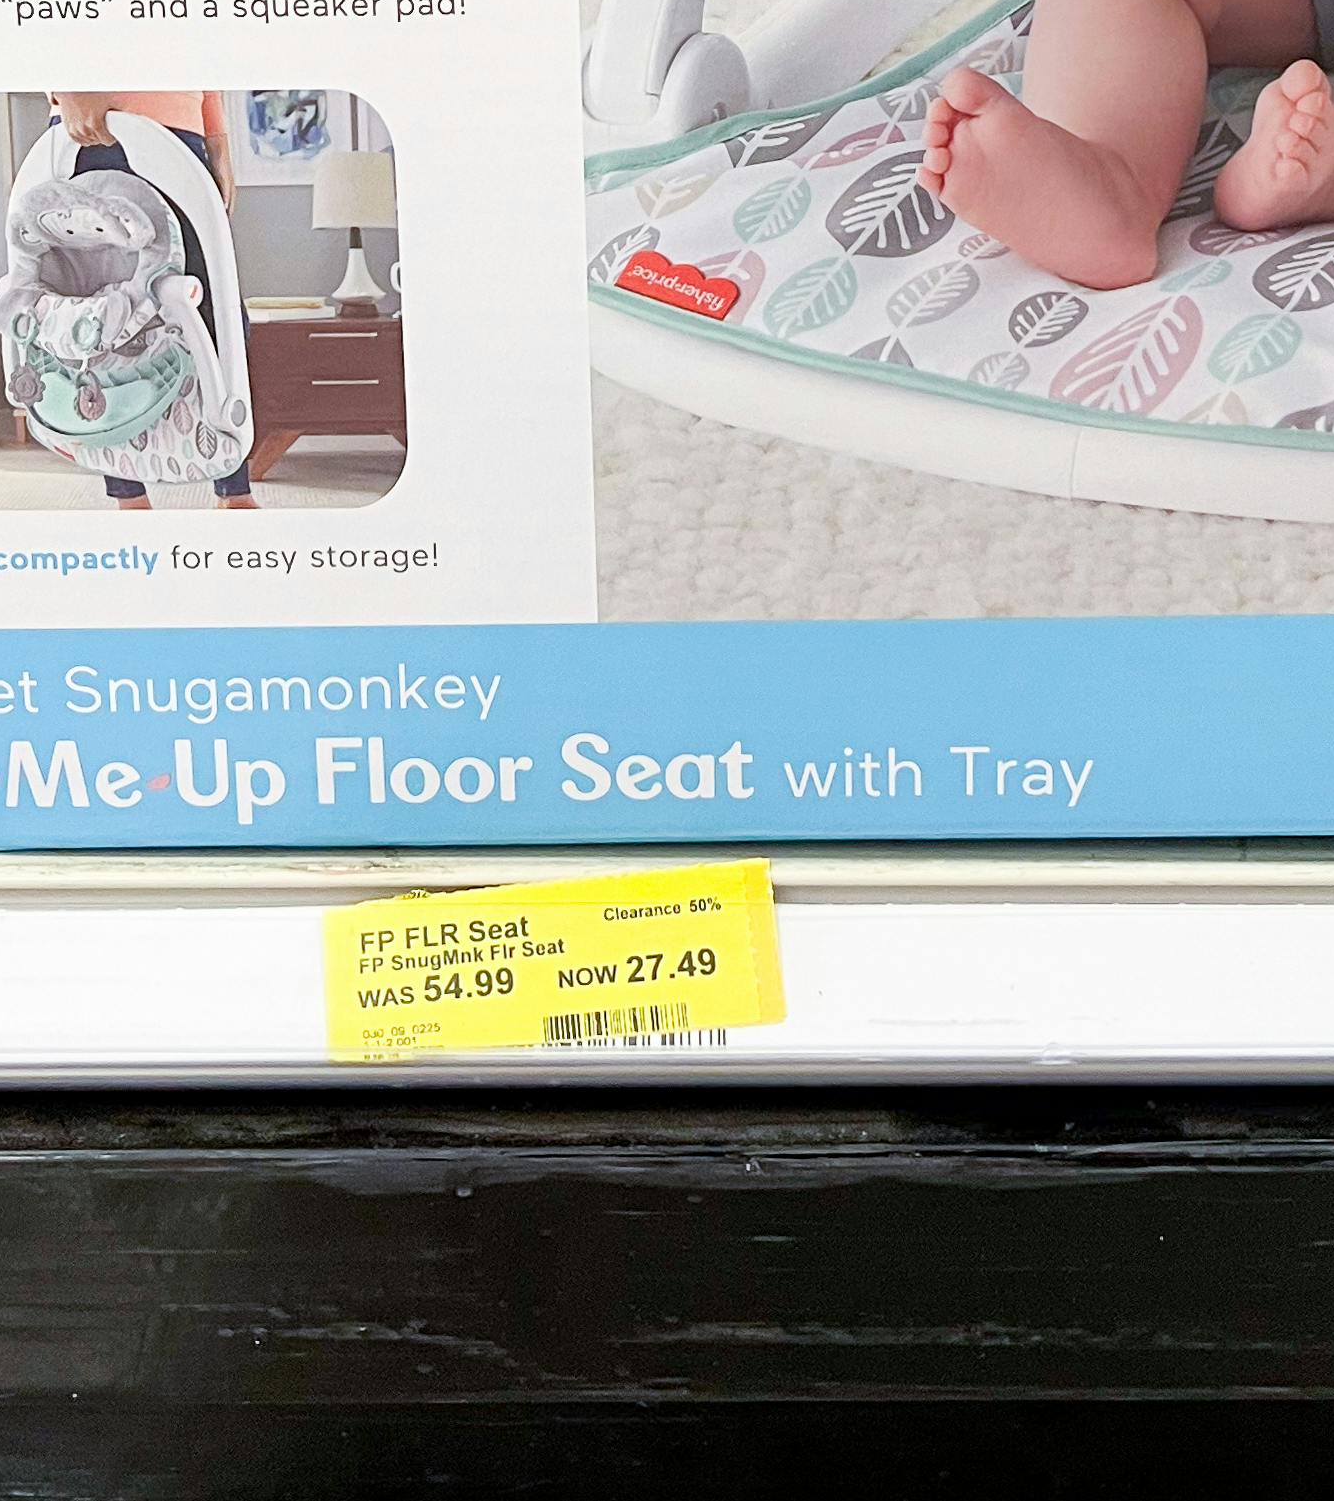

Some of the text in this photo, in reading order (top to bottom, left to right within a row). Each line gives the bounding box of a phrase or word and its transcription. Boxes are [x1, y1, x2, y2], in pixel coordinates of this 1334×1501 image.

[170, 543, 213, 570] for
[226, 548, 297, 573] easy
[309, 542, 440, 572] storage!
[64, 663, 502, 725] Snugamonkey
[314, 735, 533, 805] Floor
[561, 732, 755, 801] Seat
[783, 745, 923, 798] with
[949, 745, 1094, 808] Tray
[603, 897, 722, 922] Clearance 50%
[359, 916, 530, 954] FP FLR Seat
[359, 938, 566, 975] FP SnugMnk Flr Seat
[357, 948, 718, 1010] WAS 54.99 NOW 27.49
